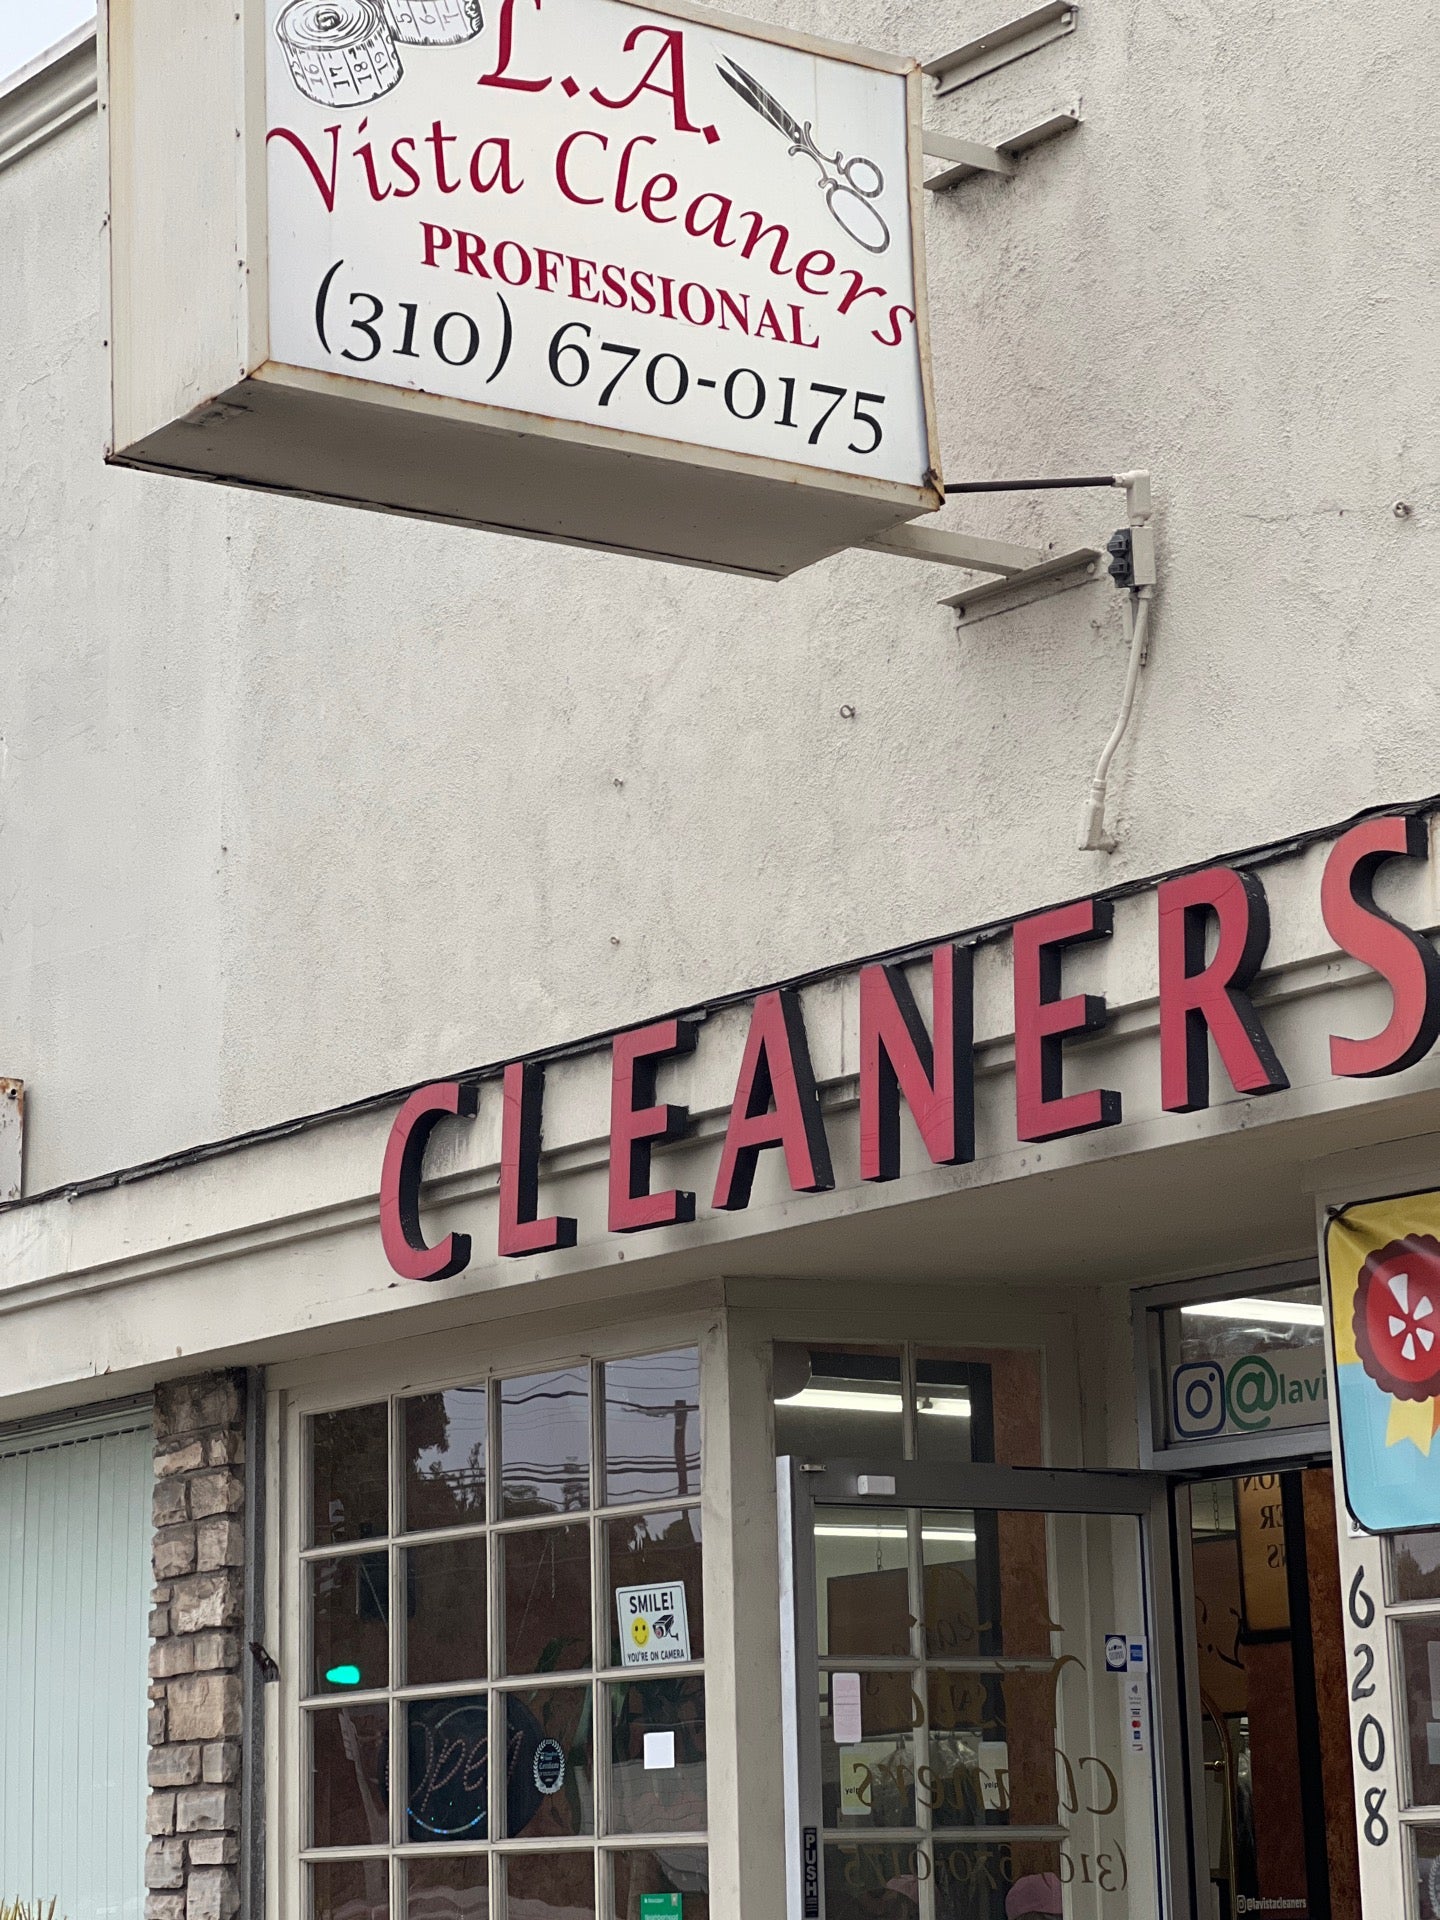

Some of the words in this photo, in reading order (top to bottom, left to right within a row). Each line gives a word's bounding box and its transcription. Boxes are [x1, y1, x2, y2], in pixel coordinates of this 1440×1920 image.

[353, 61, 373, 84] 18
[477, 0, 722, 145] L.A.
[266, 116, 524, 214] Vista
[554, 130, 915, 347] Cleaners
[419, 220, 820, 350] PROFESSIONAL
[315, 259, 513, 384] (310)
[548, 321, 887, 455] 670-0175
[380, 814, 1440, 1282] CLEANERS
[627, 1651, 649, 1663] YOU'RE
[650, 1650, 660, 1661] ON
[660, 1649, 685, 1660] CAMERA
[629, 1591, 674, 1614] SMILE!
[1349, 1565, 1389, 1847] 6208
[805, 1833, 818, 1897] PUSH
